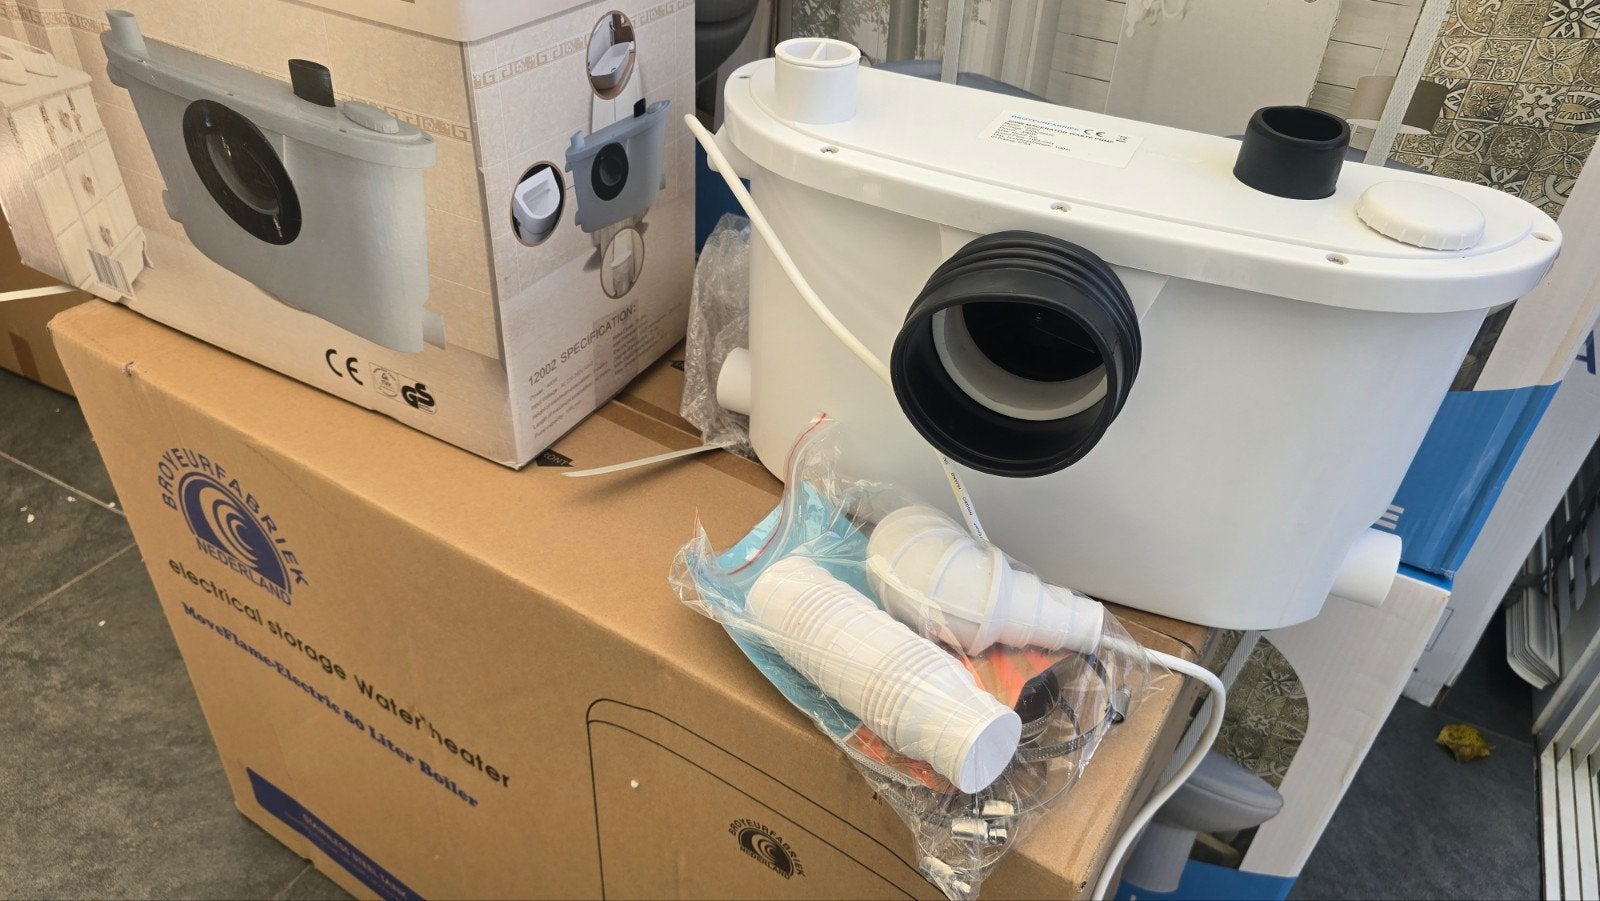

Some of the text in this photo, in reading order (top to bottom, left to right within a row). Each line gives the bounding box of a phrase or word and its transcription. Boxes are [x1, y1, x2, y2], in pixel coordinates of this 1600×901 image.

[325, 348, 364, 386] CE
[528, 359, 557, 387] 12002
[560, 304, 636, 364] SPECIFICATION:
[158, 447, 310, 587] BROYEURFABRIEK
[195, 537, 292, 606] NEDERLAND
[169, 558, 511, 788] electrical storage Water heater
[343, 708, 366, 732] 80
[368, 724, 414, 765] Liter
[418, 757, 479, 808] Boiler
